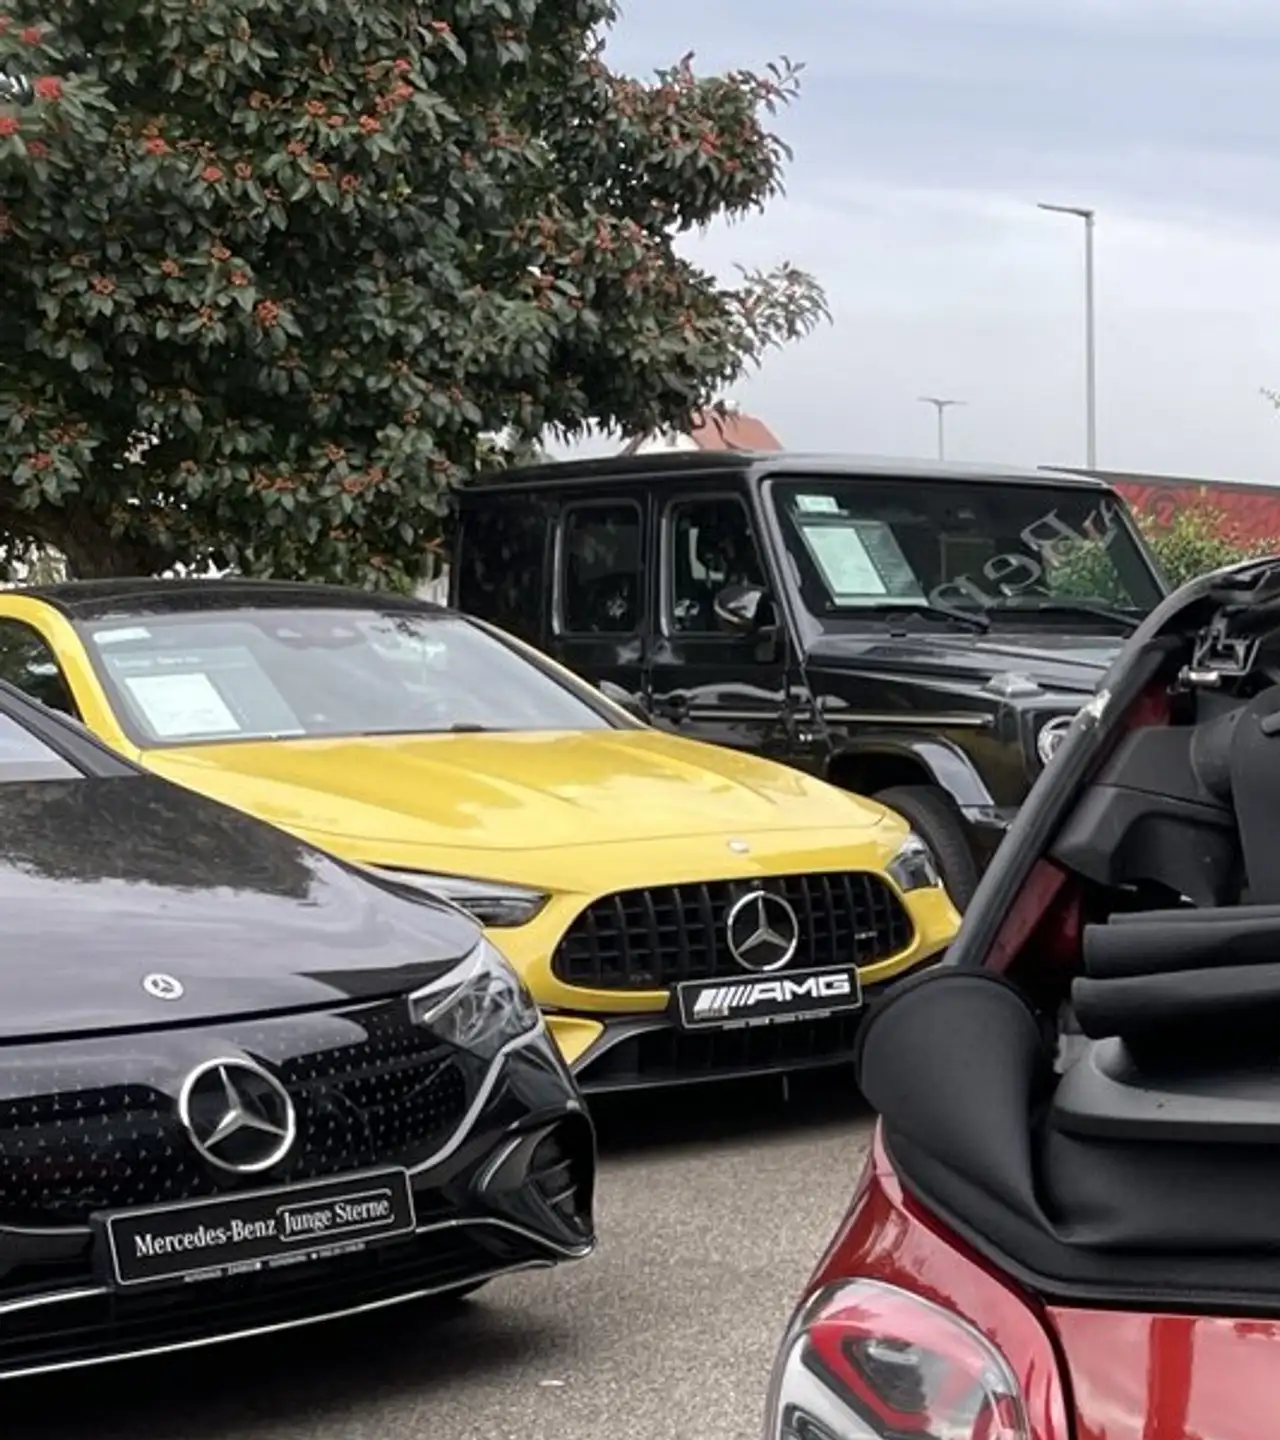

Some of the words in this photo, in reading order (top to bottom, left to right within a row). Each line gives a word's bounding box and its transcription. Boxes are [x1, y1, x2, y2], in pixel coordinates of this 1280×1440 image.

[134, 1219, 277, 1257] Mercedes-Benz
[281, 1206, 332, 1235] Junge
[335, 1199, 390, 1224] Sterne
